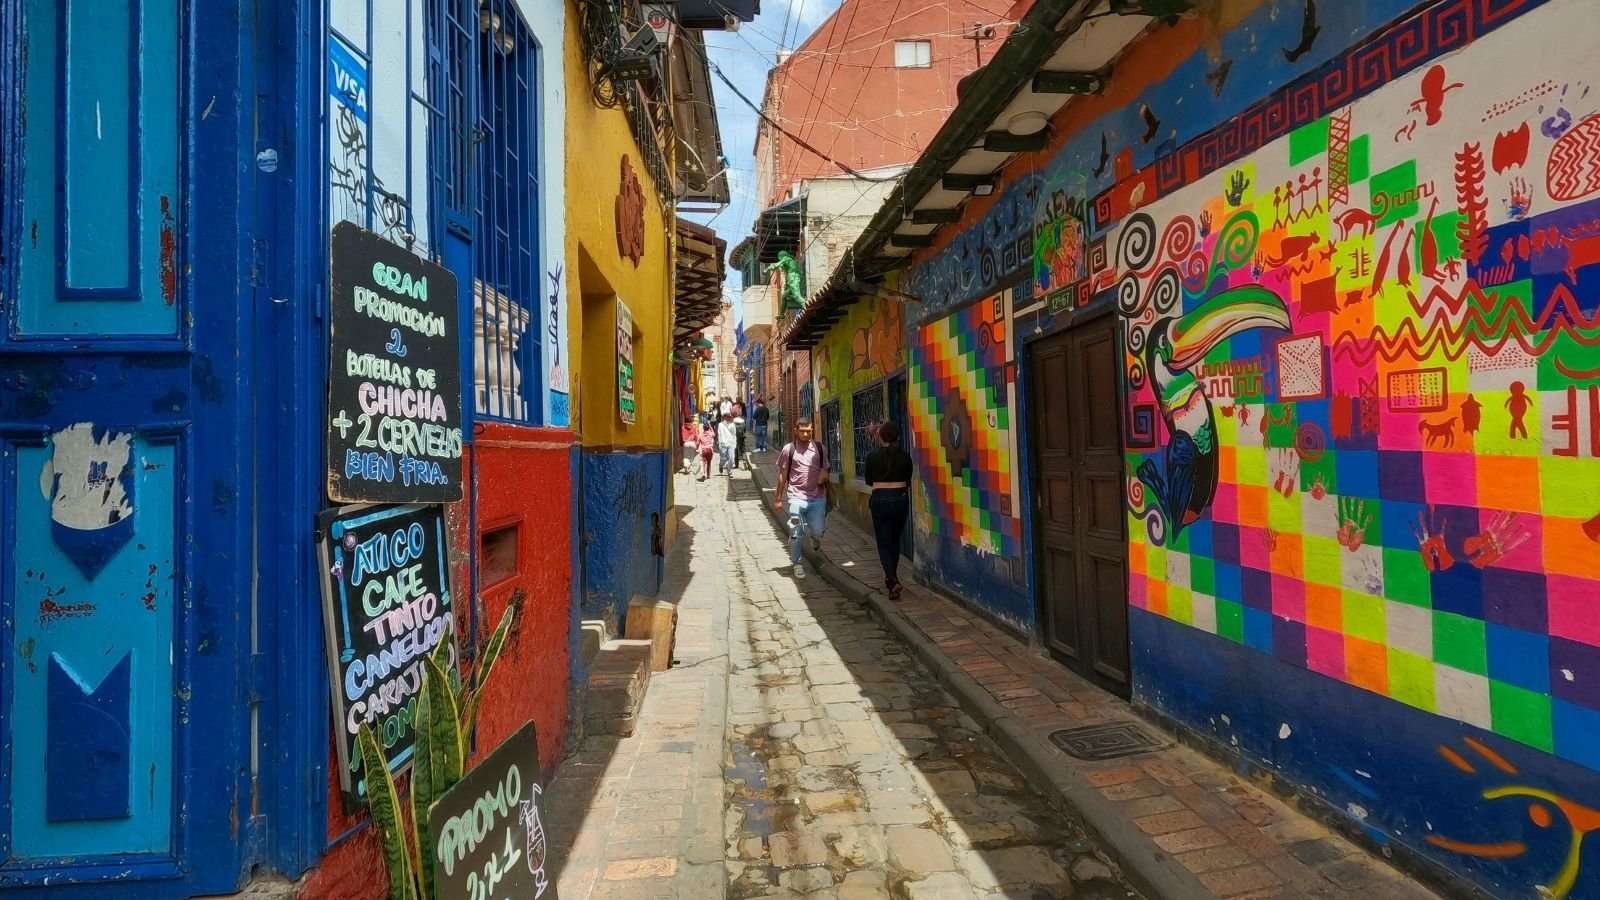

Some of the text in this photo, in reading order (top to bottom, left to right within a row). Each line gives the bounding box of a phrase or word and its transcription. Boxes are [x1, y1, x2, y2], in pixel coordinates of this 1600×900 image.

[330, 58, 367, 113] VISA
[372, 261, 428, 302] GRAN
[385, 328, 408, 357] 2
[346, 348, 437, 390] BOTELLAS DE
[358, 381, 447, 422] CHICHA
[355, 413, 377, 448] 2
[377, 415, 463, 459] CERVEZAS
[344, 448, 395, 483] BIEN
[351, 522, 425, 586] ATICO
[362, 563, 427, 617] CAFE
[363, 592, 437, 646] TINTO
[437, 764, 521, 876] PROMO
